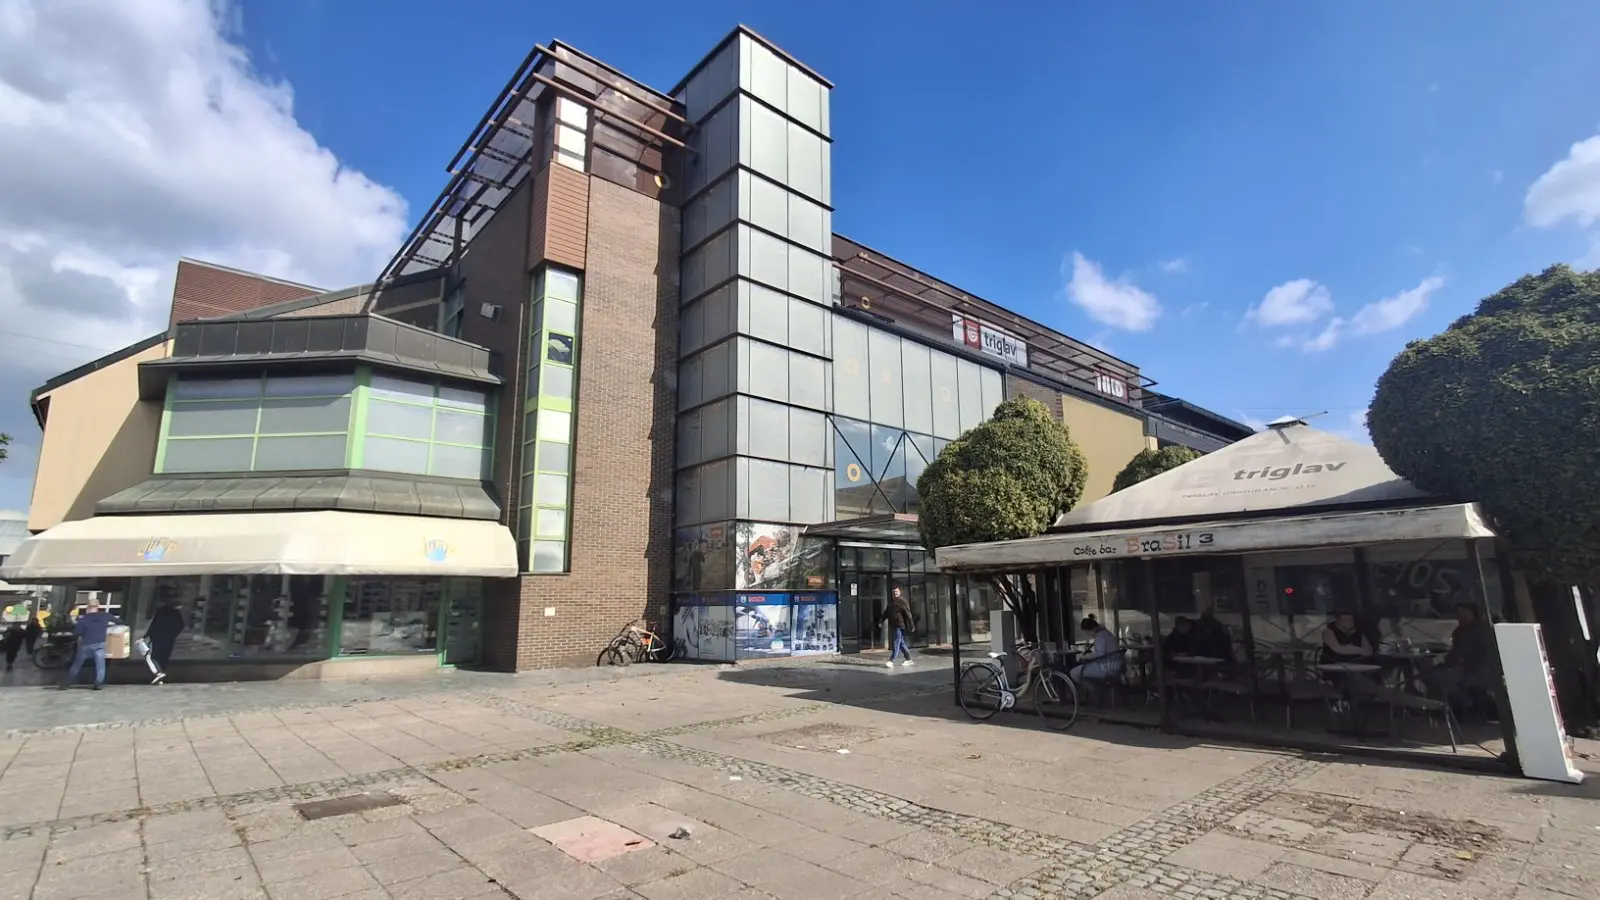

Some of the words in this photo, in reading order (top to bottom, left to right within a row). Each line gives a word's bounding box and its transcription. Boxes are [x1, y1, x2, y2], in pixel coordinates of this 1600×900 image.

[984, 332, 1016, 356] triglav
[1234, 462, 1346, 480] triglav
[1199, 533, 1214, 545] 3
